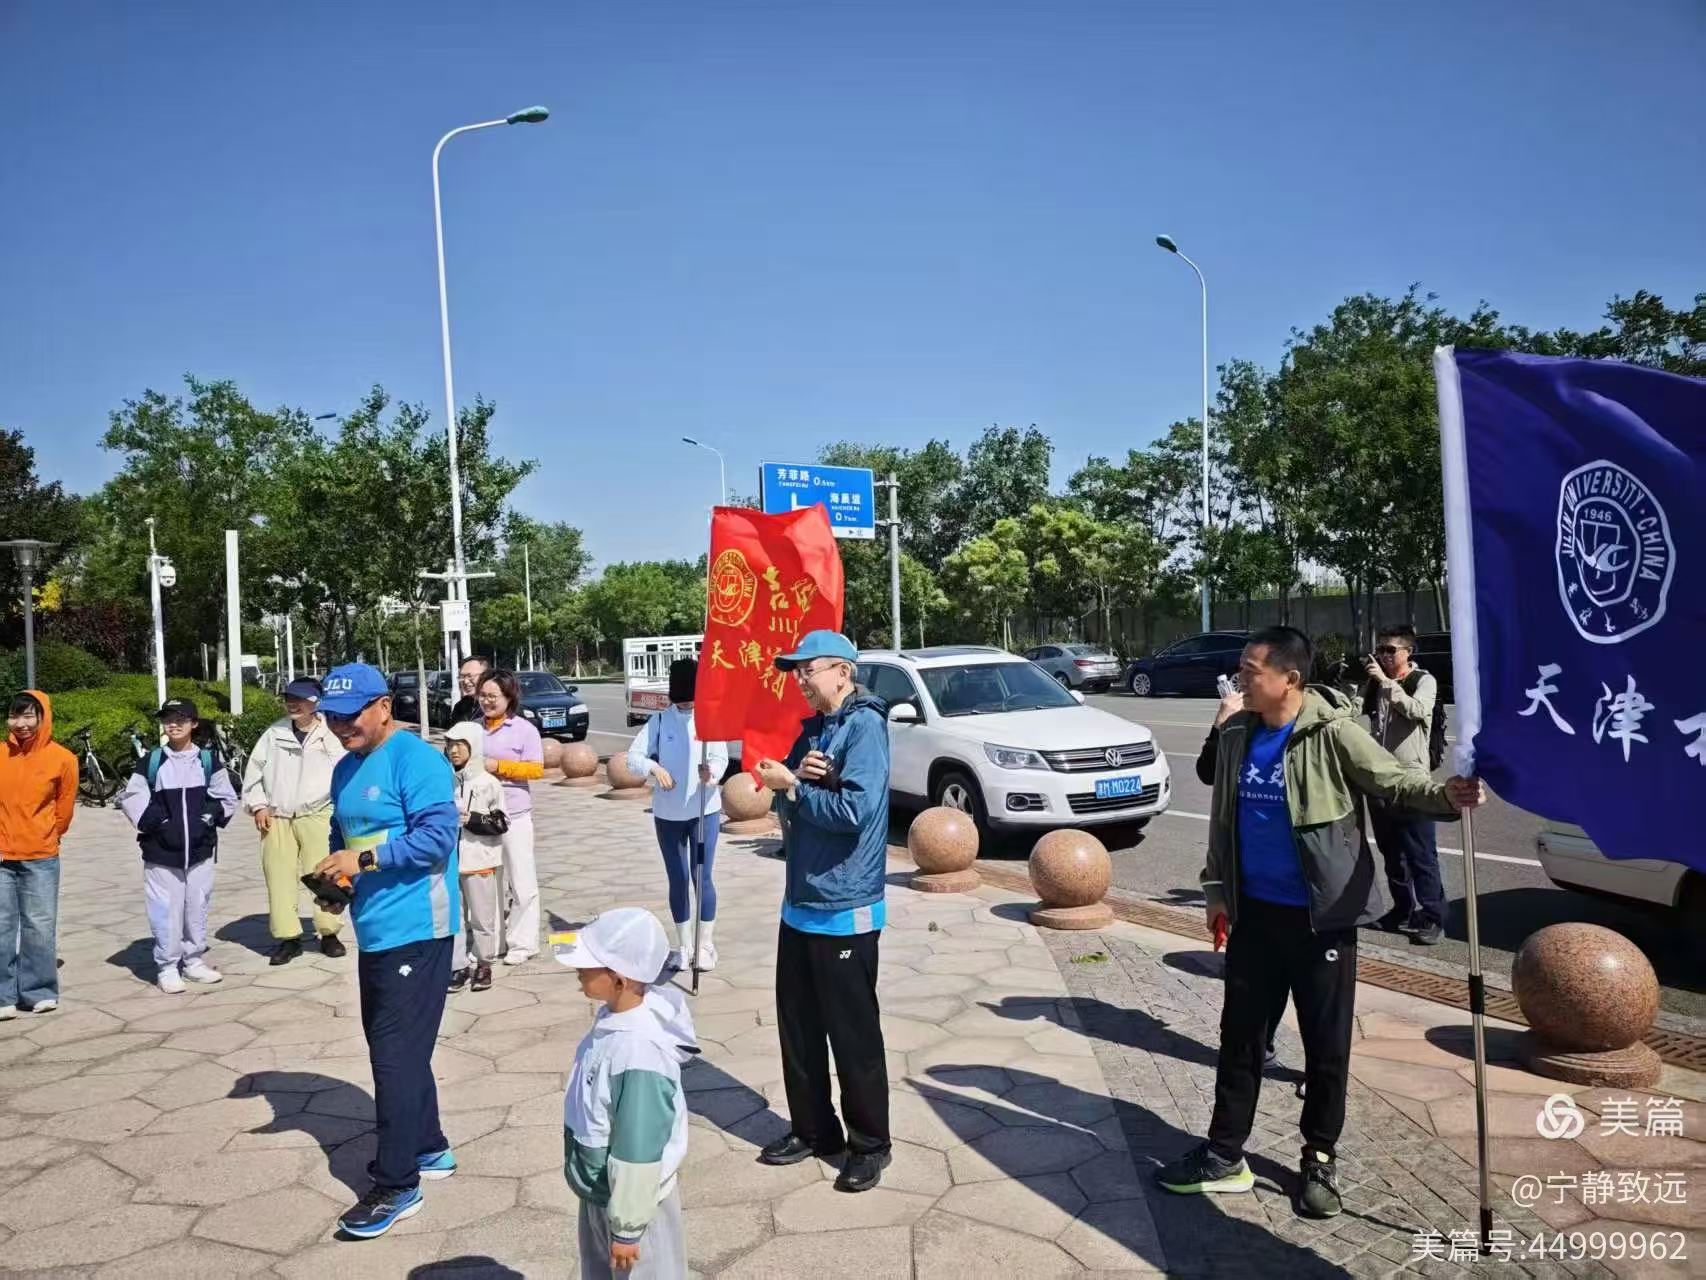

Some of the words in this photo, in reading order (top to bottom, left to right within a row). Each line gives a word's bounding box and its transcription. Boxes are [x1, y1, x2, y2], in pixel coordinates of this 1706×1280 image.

[1564, 471, 1645, 512] UNIVERSITY
[1561, 511, 1575, 559] JILIN
[1584, 508, 1612, 522] 1946
[1636, 516, 1666, 581] CHINA
[324, 679, 352, 690] JLU
